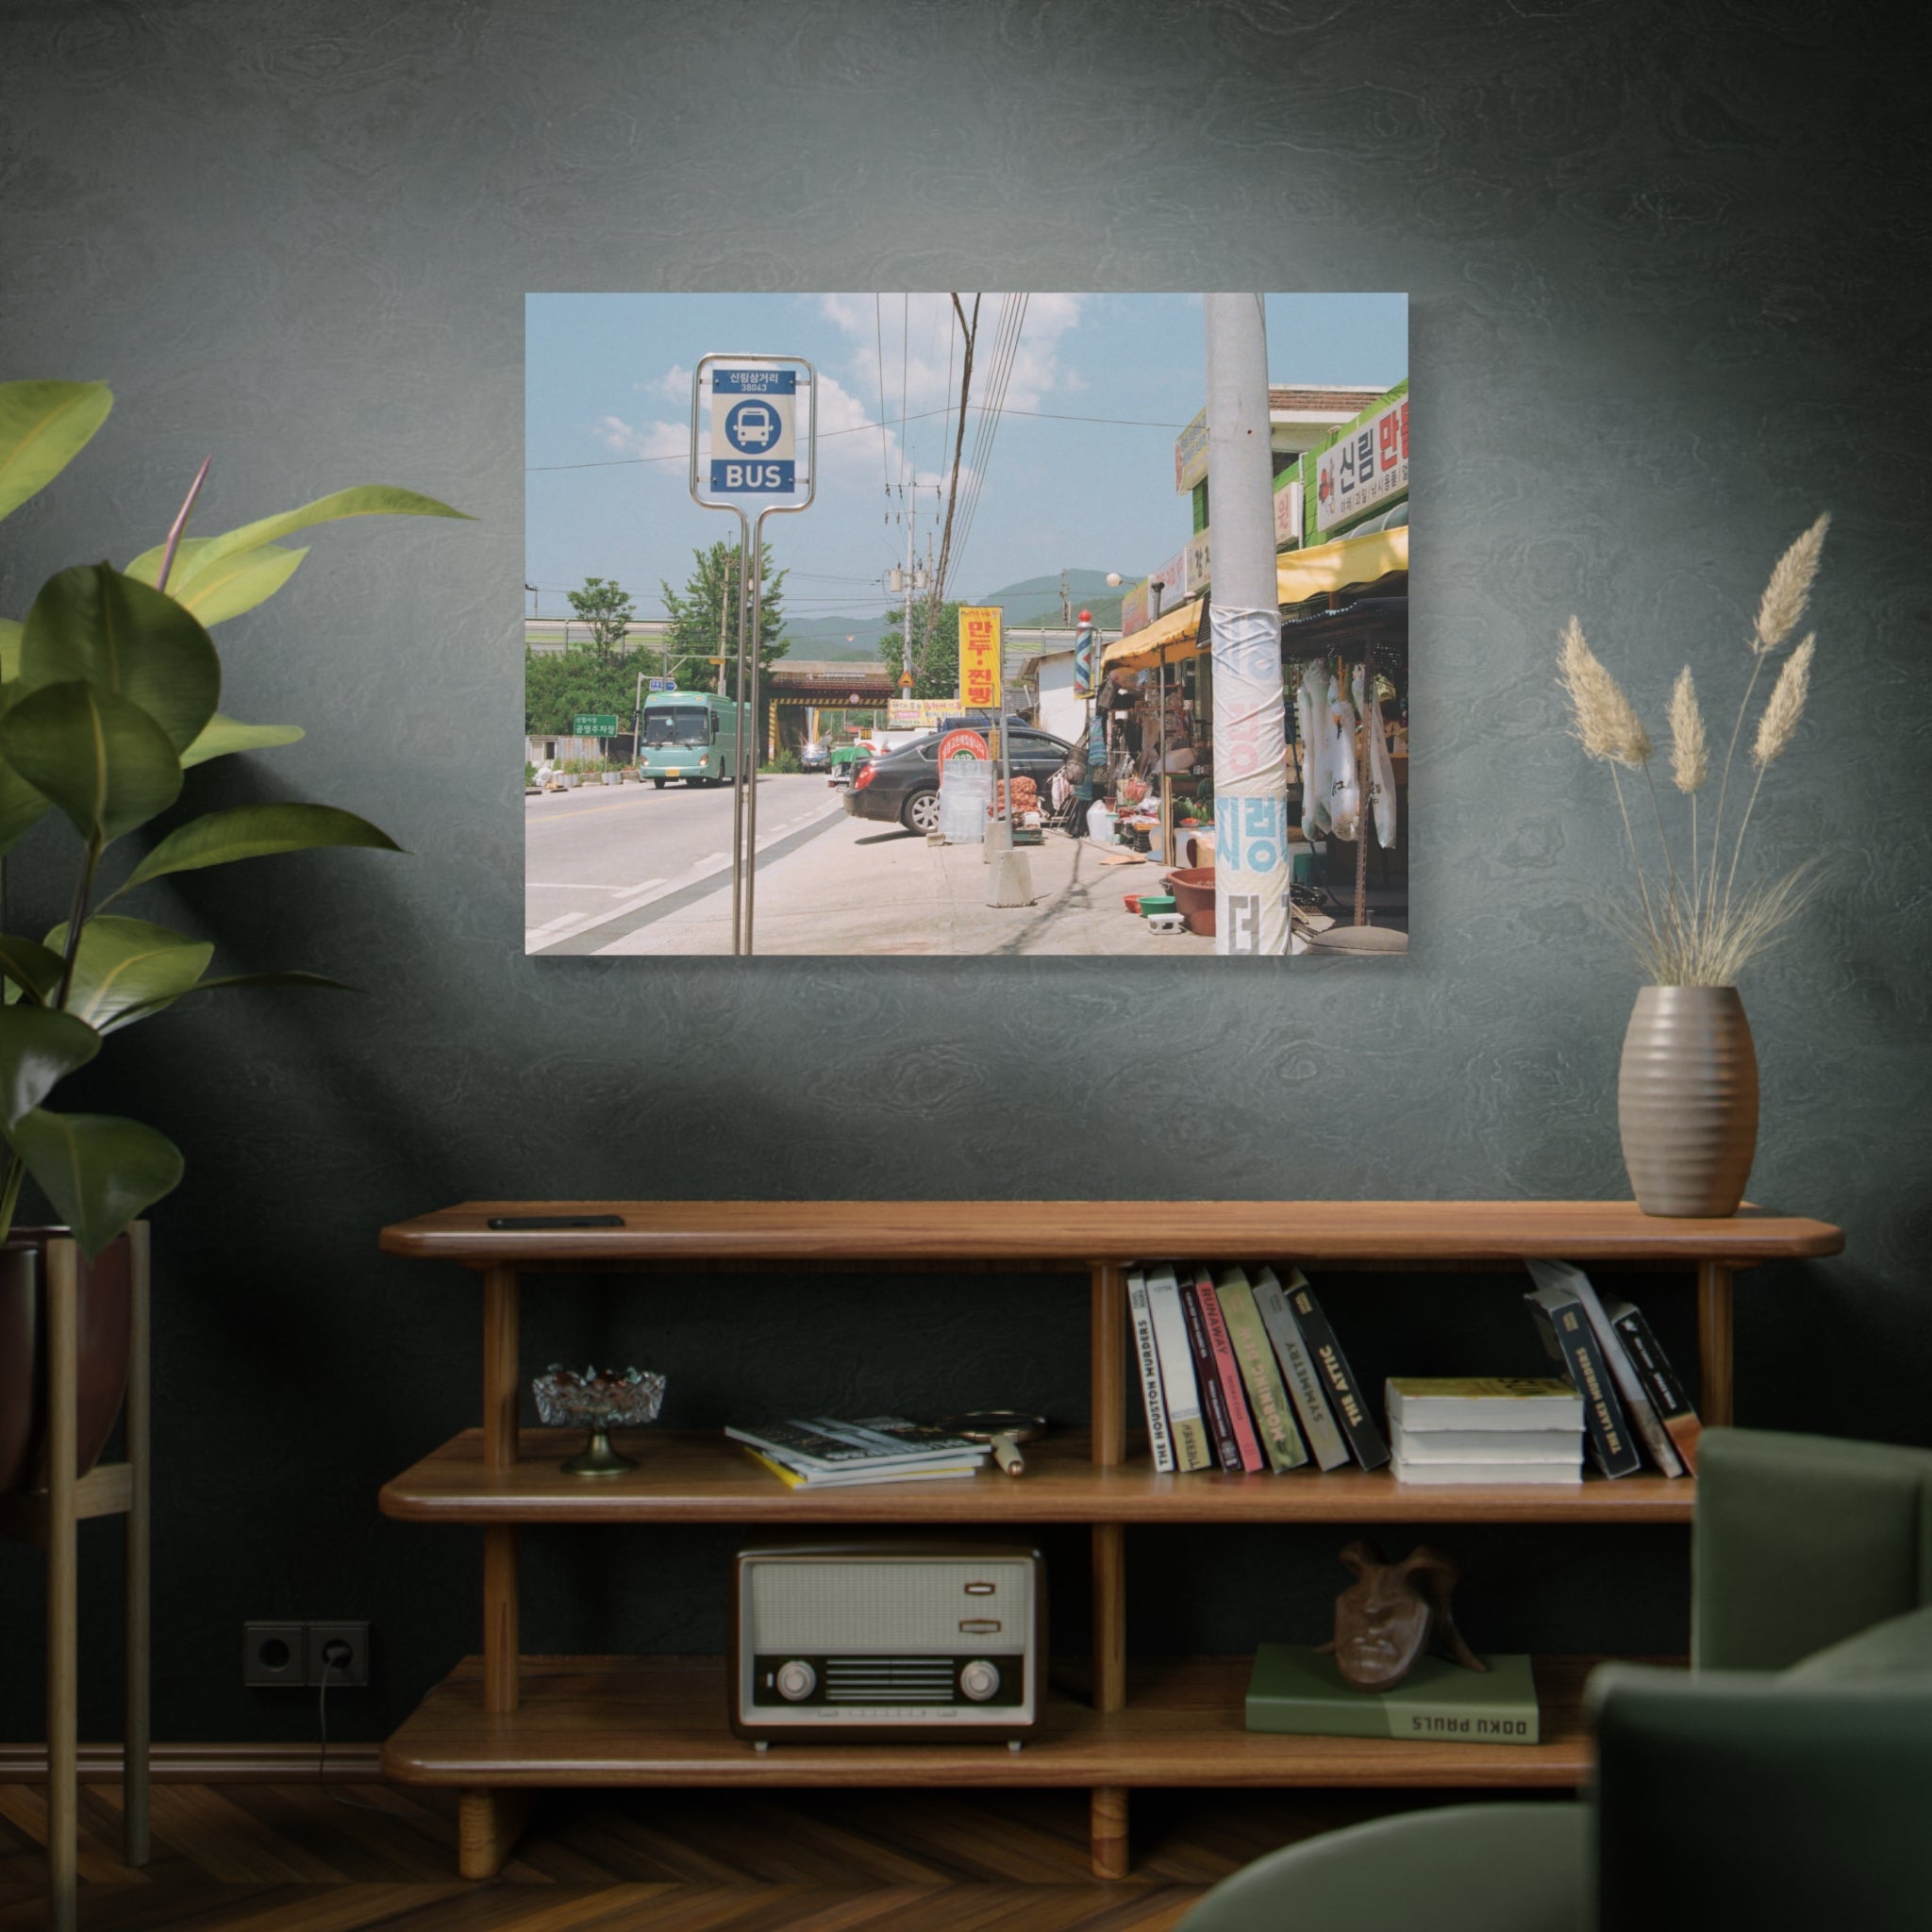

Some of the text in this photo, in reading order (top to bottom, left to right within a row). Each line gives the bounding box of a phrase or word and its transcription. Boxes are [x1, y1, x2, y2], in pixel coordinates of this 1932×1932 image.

[741, 383, 767, 391] 38043
[725, 465, 782, 488] BUS
[575, 724, 615, 735] 공영주차장
[1201, 1287, 1229, 1355] RUNAWAY
[1238, 1326, 1260, 1361] DEW
[1139, 1319, 1170, 1466] THE HOUSTON MURDERS
[1250, 1364, 1287, 1442] MORNING
[1285, 1341, 1324, 1424] SYMMETRY
[1319, 1344, 1363, 1428] THE ATTIC
[1606, 1430, 1622, 1456] THE
